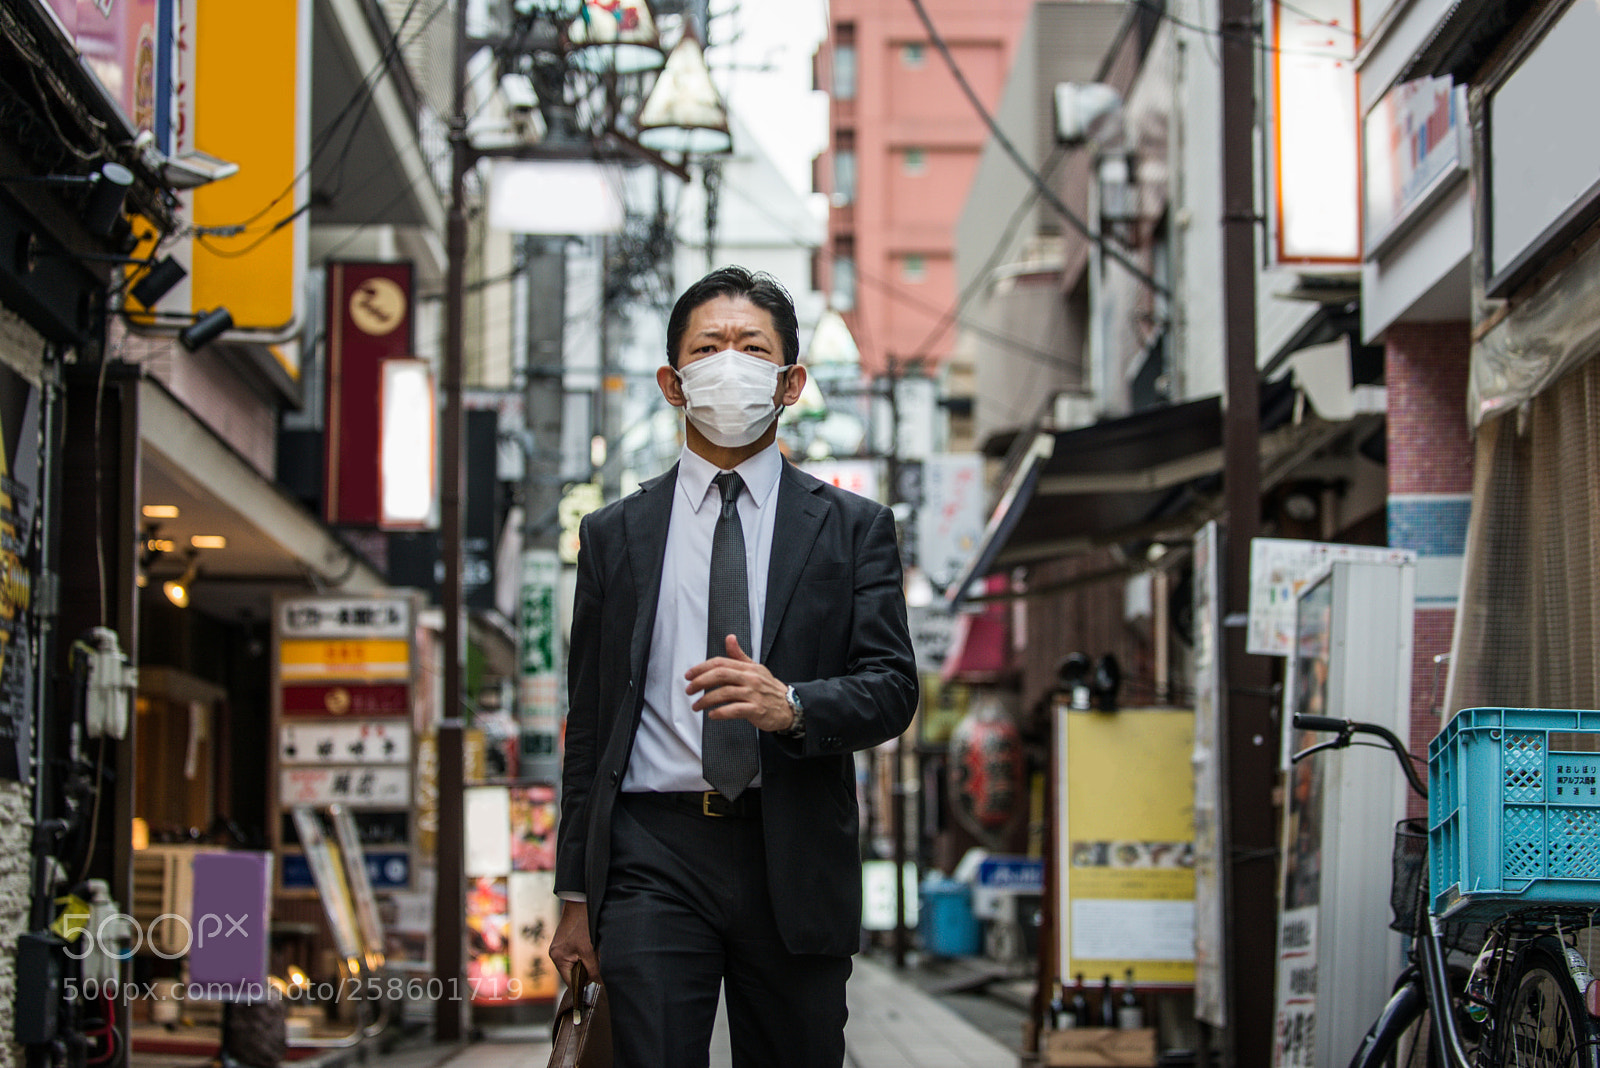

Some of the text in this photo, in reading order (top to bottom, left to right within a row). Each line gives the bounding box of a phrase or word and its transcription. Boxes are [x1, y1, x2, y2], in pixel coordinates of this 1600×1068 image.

[1557, 765, 1597, 774] 貸おしぼり
